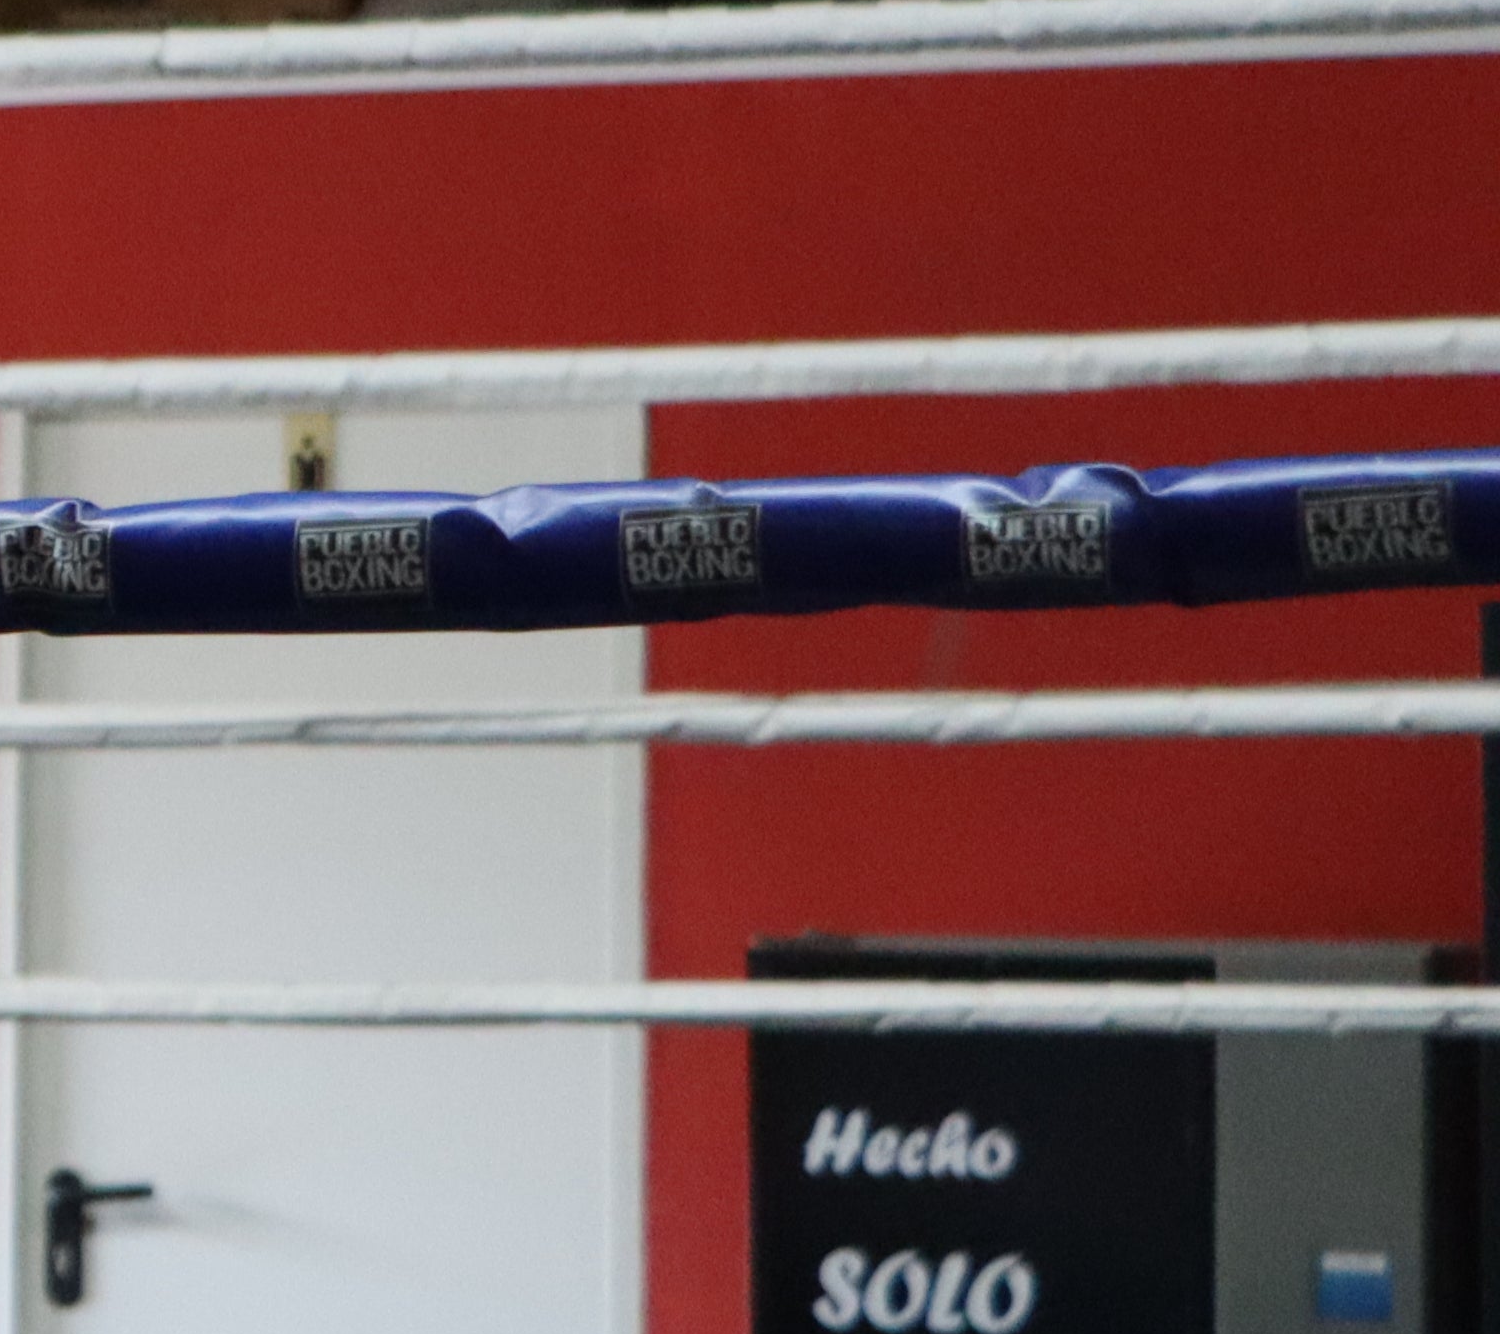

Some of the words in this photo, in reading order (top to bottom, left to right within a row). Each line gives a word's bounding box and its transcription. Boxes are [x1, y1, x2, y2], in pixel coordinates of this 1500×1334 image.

[1308, 498, 1440, 529] PUEBLO
[301, 531, 419, 556] PUEBLO
[626, 519, 750, 548] PUEBLO
[1311, 528, 1448, 566] BOXING
[306, 556, 425, 590] BOXING
[629, 548, 751, 584] BOXING
[973, 539, 1103, 573] BOXING
[2, 560, 103, 593] BOXING
[803, 1105, 1021, 1180] Hecho
